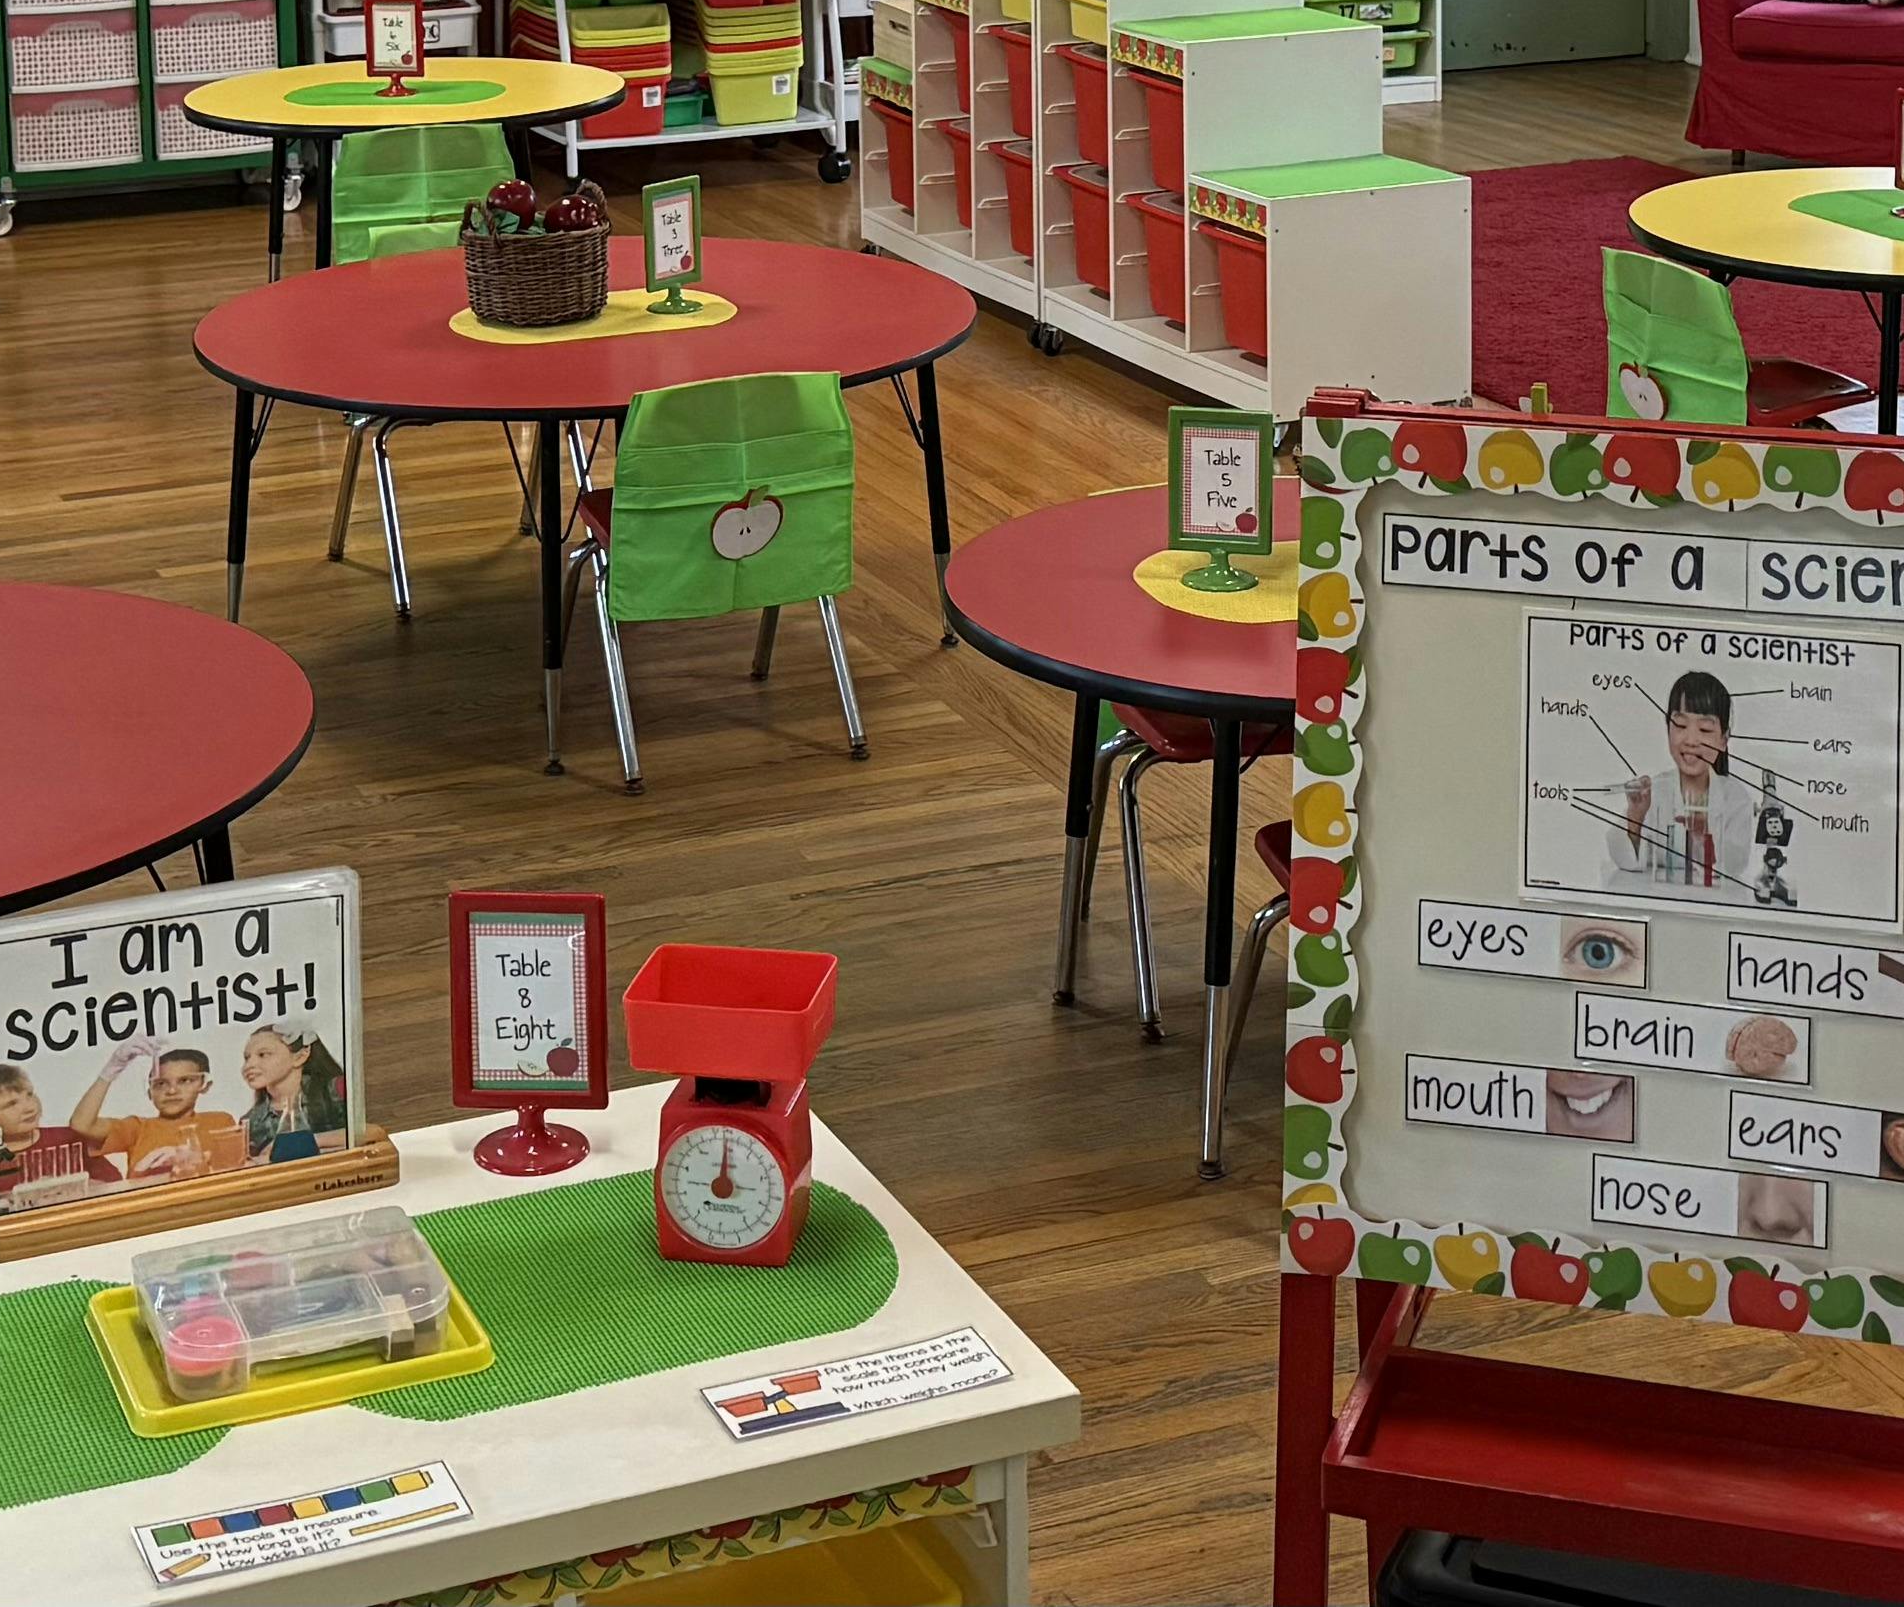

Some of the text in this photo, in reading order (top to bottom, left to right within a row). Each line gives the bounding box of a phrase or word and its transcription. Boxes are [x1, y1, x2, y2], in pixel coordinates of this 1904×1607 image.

[1339, 4, 1355, 19] 17
[1204, 447, 1241, 467] Table
[1220, 472, 1232, 487] 5
[1206, 490, 1237, 508] Five
[1574, 538, 1643, 589] of
[1670, 545, 1705, 594] a
[1655, 629, 1687, 654] of
[1700, 634, 1718, 656] a
[1728, 634, 1856, 667] scientist
[1591, 670, 1633, 691] eyes
[1790, 681, 1833, 703] brain
[1540, 696, 1589, 718] hands
[1812, 735, 1853, 756] ears
[1532, 780, 1570, 802] tools
[1806, 779, 1848, 797] nose
[1820, 812, 1870, 834] mouth
[49, 907, 270, 990] I am a
[1425, 916, 1529, 959] eyes
[495, 949, 552, 979] Table
[1736, 942, 1869, 1001] hands
[5, 961, 317, 1062] scientist!
[518, 987, 532, 1009] 8
[495, 1016, 557, 1052] Eight
[1583, 1004, 1695, 1060] brain
[1412, 1072, 1535, 1120] mouth
[1738, 1117, 1841, 1159] ears
[1599, 1175, 1702, 1220] nose
[853, 1369, 998, 1411] Which weighs more?
[160, 1546, 192, 1559] Use
[195, 1539, 227, 1553] the
[233, 1528, 274, 1548] tools
[280, 1525, 299, 1537] to
